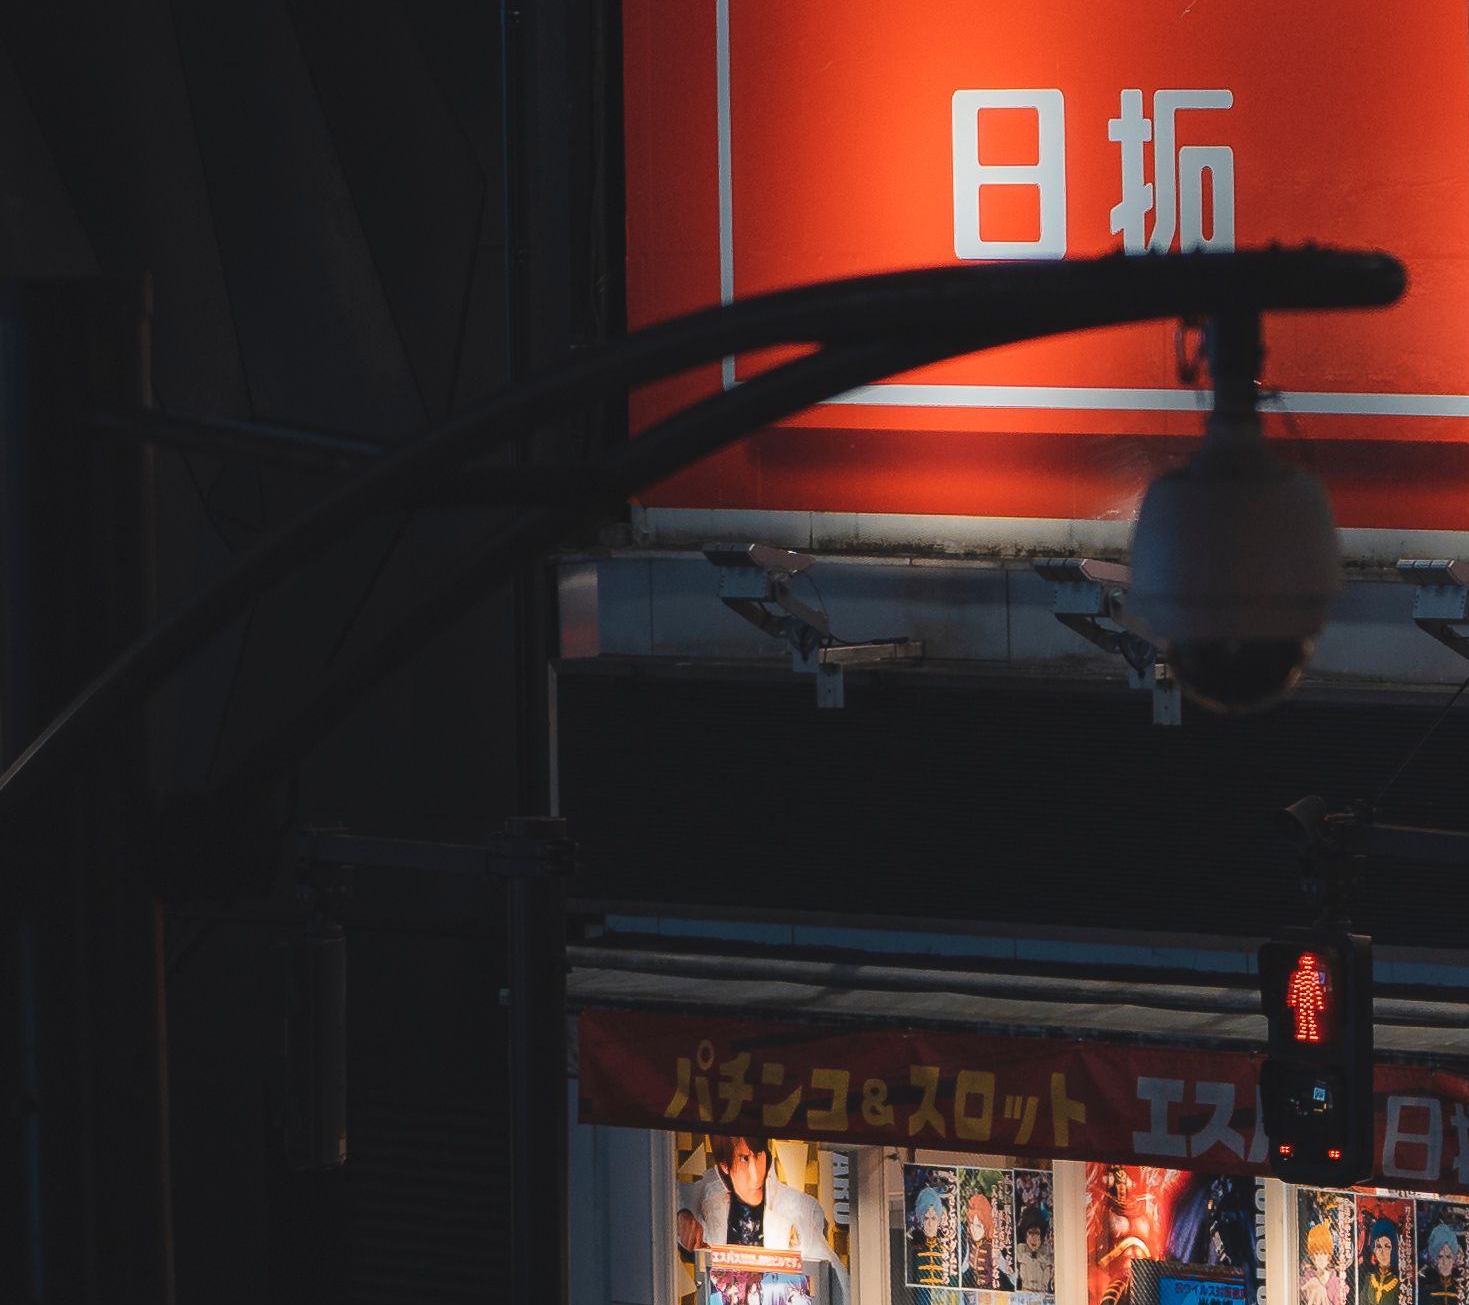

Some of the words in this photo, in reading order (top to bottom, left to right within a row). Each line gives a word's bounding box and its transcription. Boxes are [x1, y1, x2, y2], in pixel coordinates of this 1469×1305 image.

[663, 1040, 1086, 1149] パチンコ&スロット
